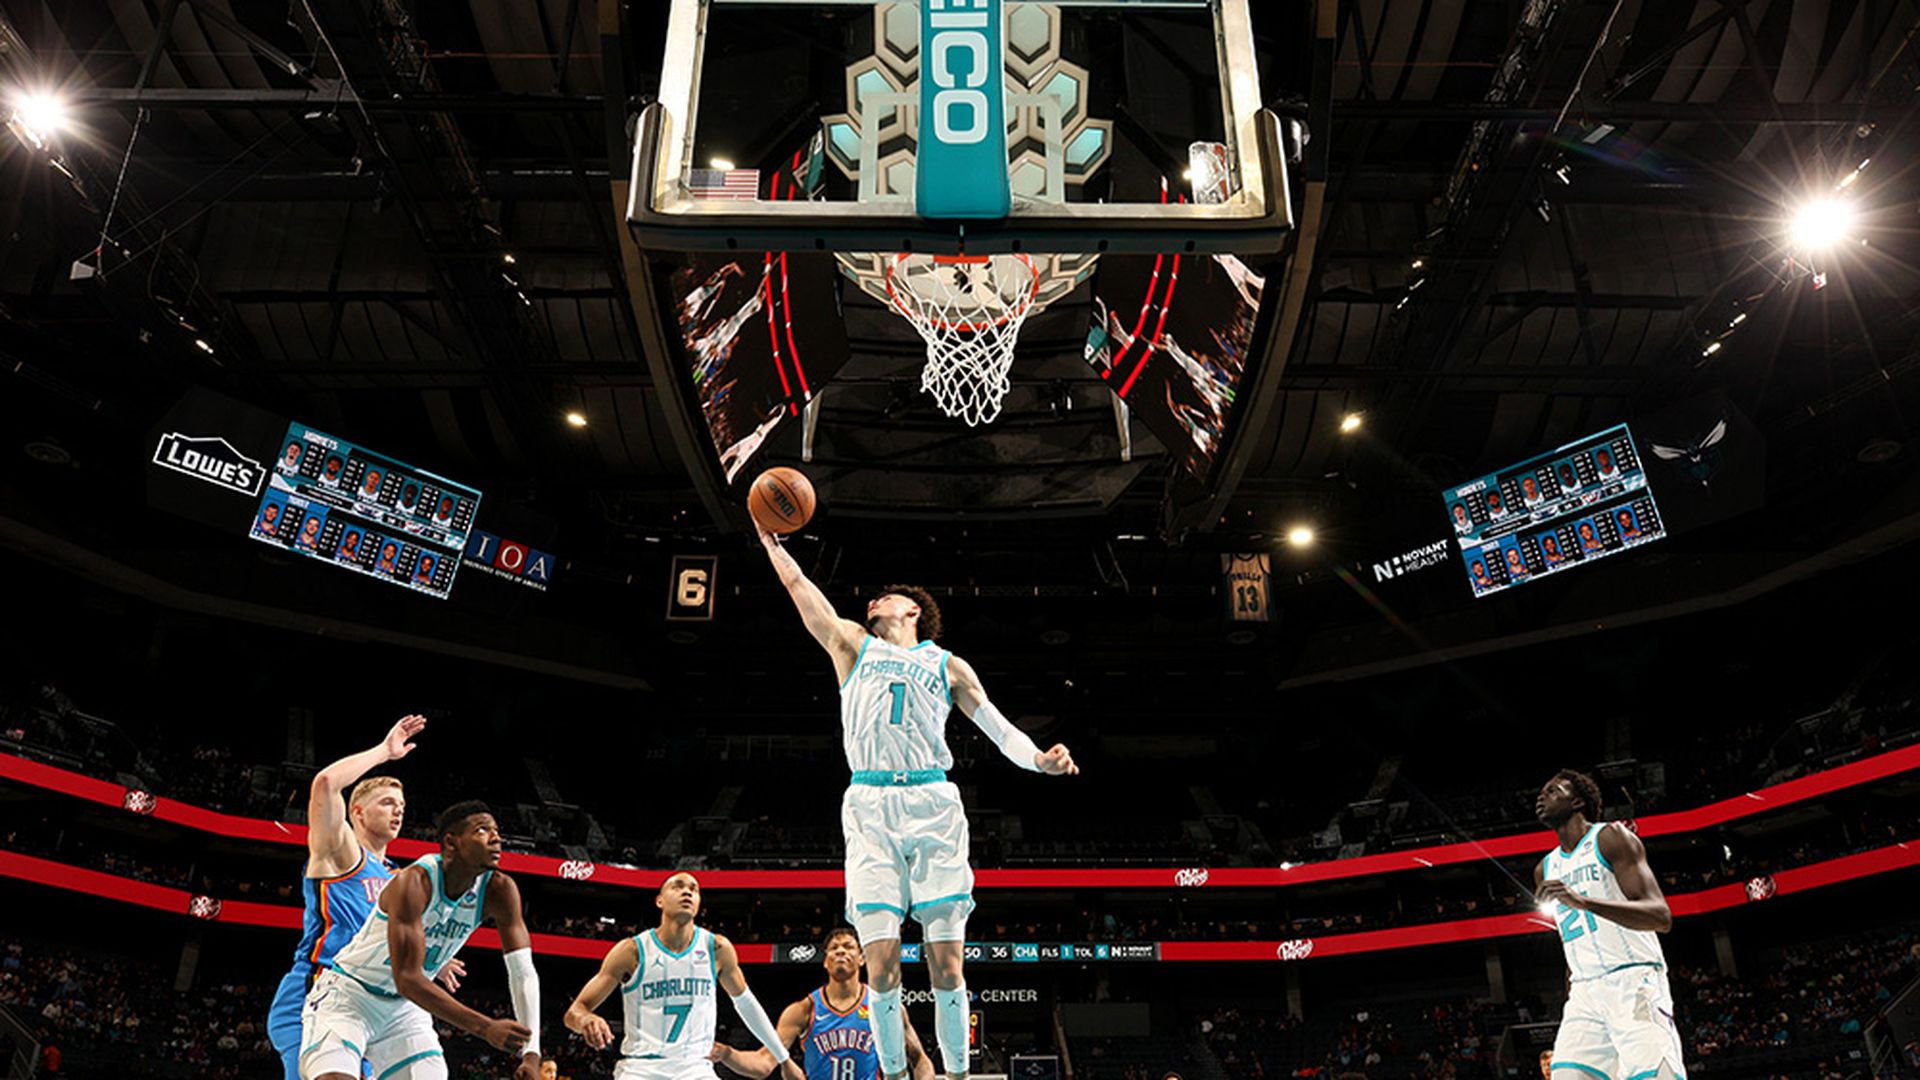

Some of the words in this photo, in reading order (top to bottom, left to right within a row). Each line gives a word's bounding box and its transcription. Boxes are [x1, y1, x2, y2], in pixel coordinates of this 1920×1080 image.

[167, 440, 253, 488] LOWE'S
[1402, 539, 1448, 563] NOVANT
[1405, 551, 1449, 573] HEALTH
[677, 569, 707, 607] 6
[1237, 585, 1259, 612] 13
[889, 682, 906, 725] 1
[992, 946, 1008, 958] 36
[1014, 946, 1038, 958] CHA
[1075, 947, 1092, 957] TOL
[642, 978, 712, 1001] CHARLOTTE
[981, 989, 1038, 1002] CENTER
[663, 1004, 692, 1043] 7
[829, 1056, 856, 1080] 18
